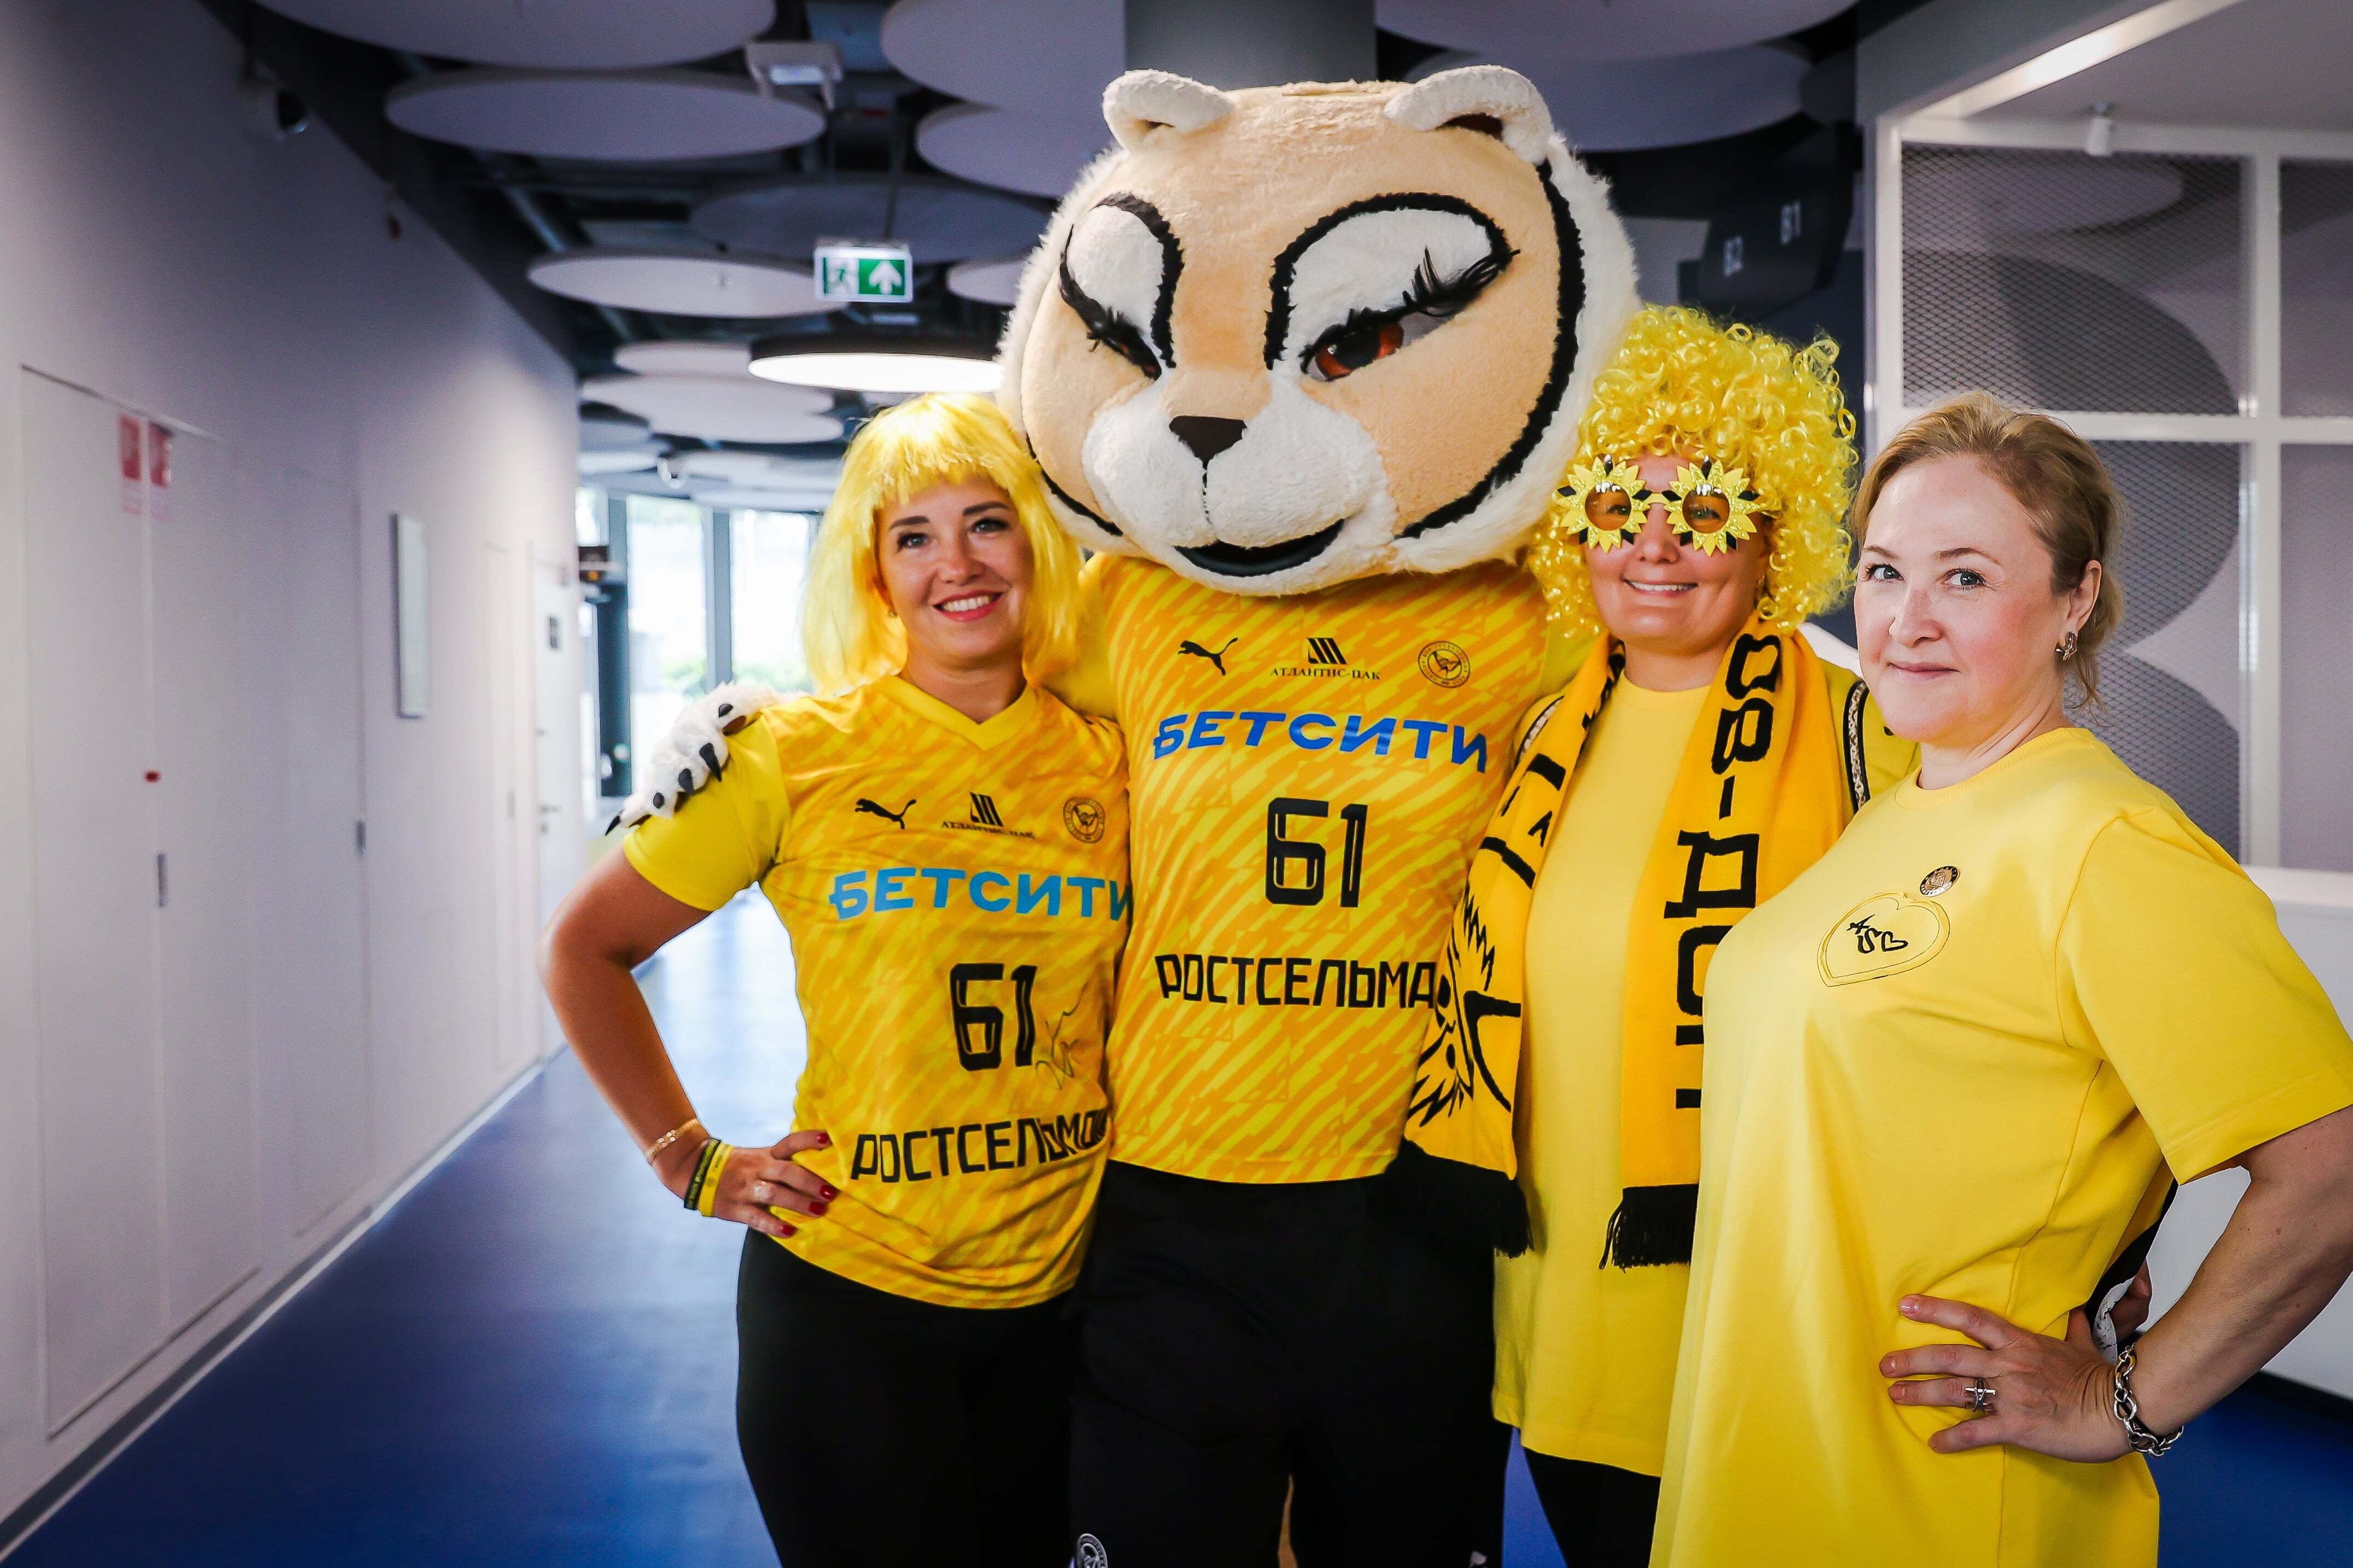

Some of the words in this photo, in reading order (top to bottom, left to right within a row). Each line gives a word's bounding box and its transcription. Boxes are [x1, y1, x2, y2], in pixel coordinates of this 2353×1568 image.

[1153, 710, 1488, 774] БЕТСИТИ
[1265, 797, 1368, 908] 61
[828, 867, 1134, 925] БЕТСИТИ
[1154, 953, 1437, 1009] РОСТСЕЛЬМА
[949, 962, 1038, 1072] 61
[850, 1109, 1107, 1184] РОСТСЕЛЬМА
